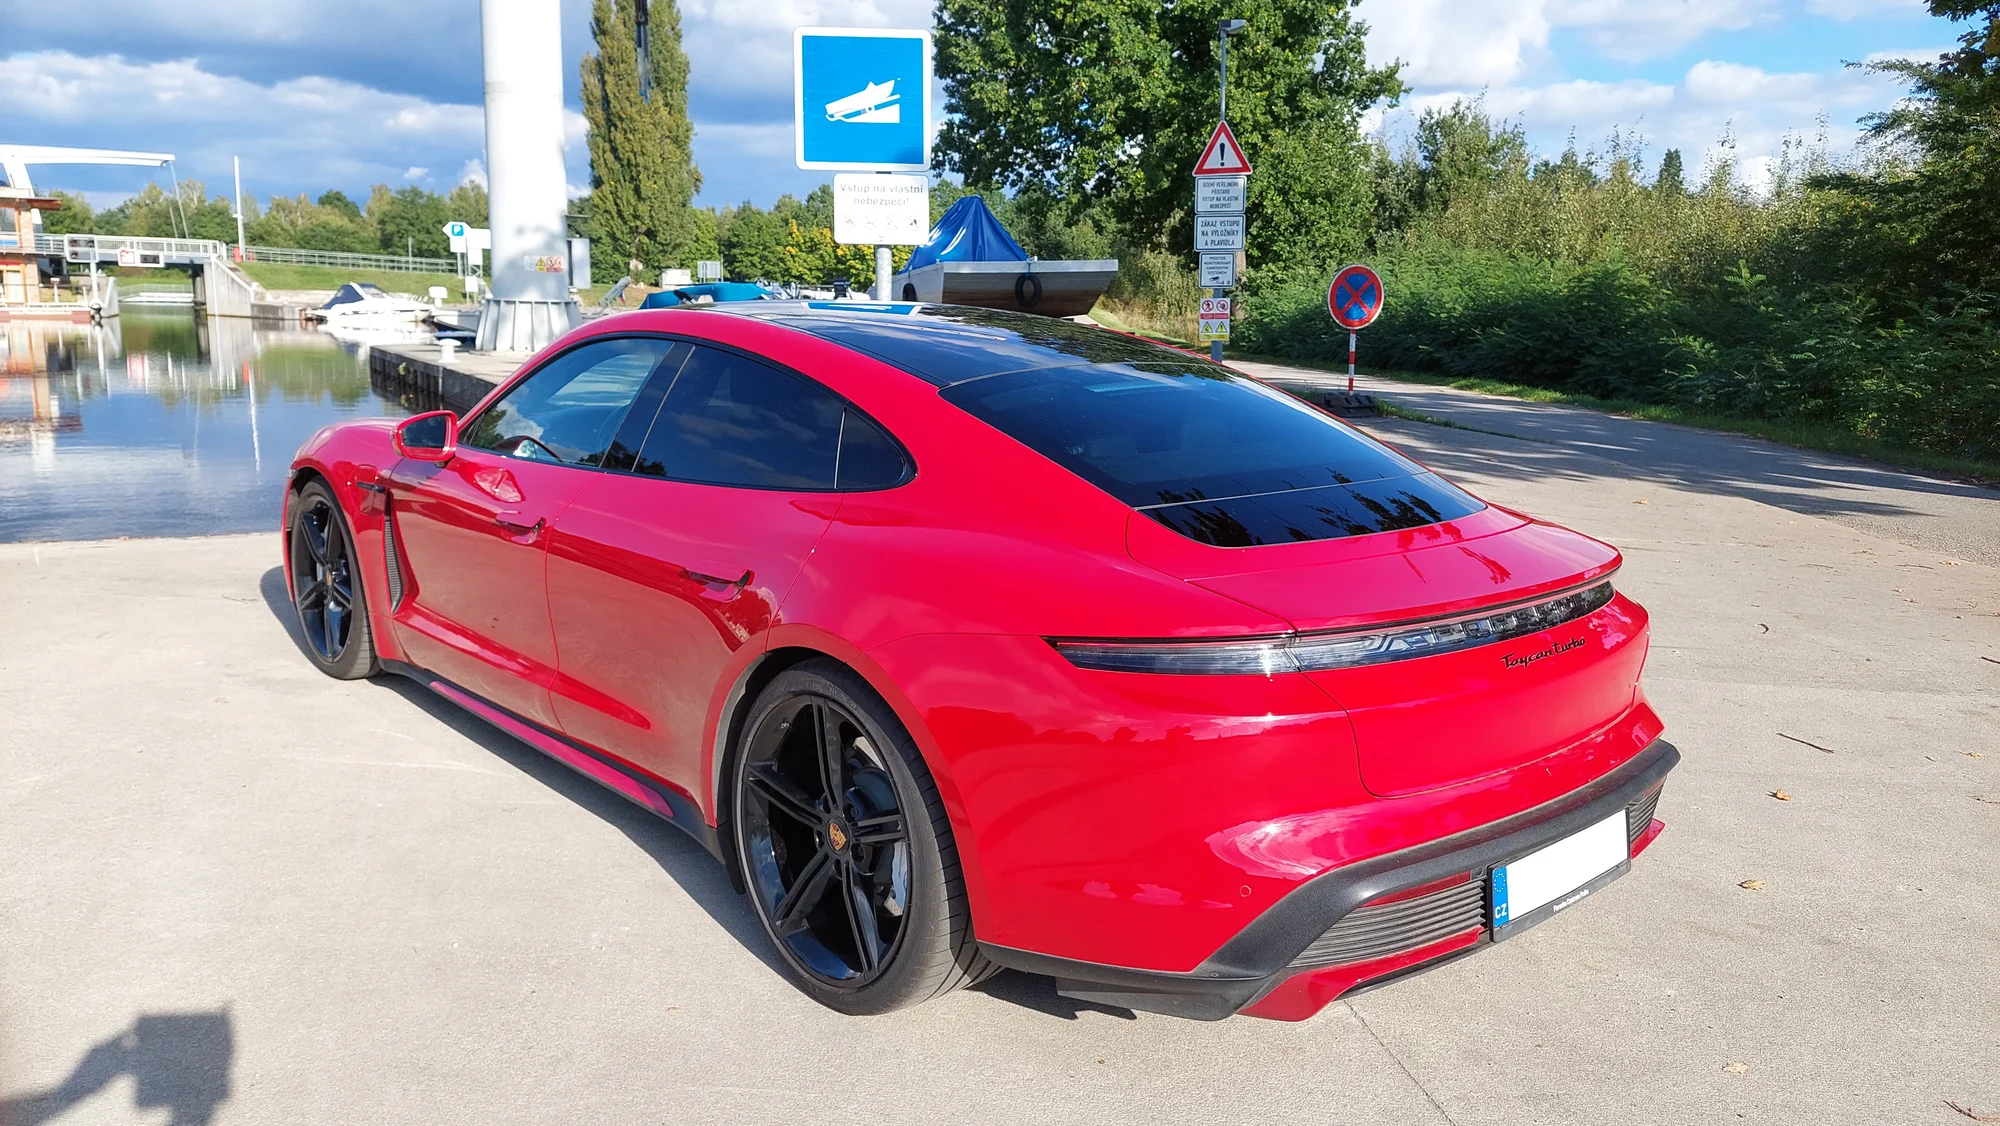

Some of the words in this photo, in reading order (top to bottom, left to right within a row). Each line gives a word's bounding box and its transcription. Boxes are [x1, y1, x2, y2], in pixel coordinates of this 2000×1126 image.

[840, 184, 870, 194] Vstup
[1201, 219, 1217, 227] ZÁKAZ
[1211, 228, 1239, 237] VÝLOŽNÍKY
[1501, 649, 1552, 669] Taycan
[1552, 637, 1585, 654] turbo
[1495, 903, 1507, 919] CZ
